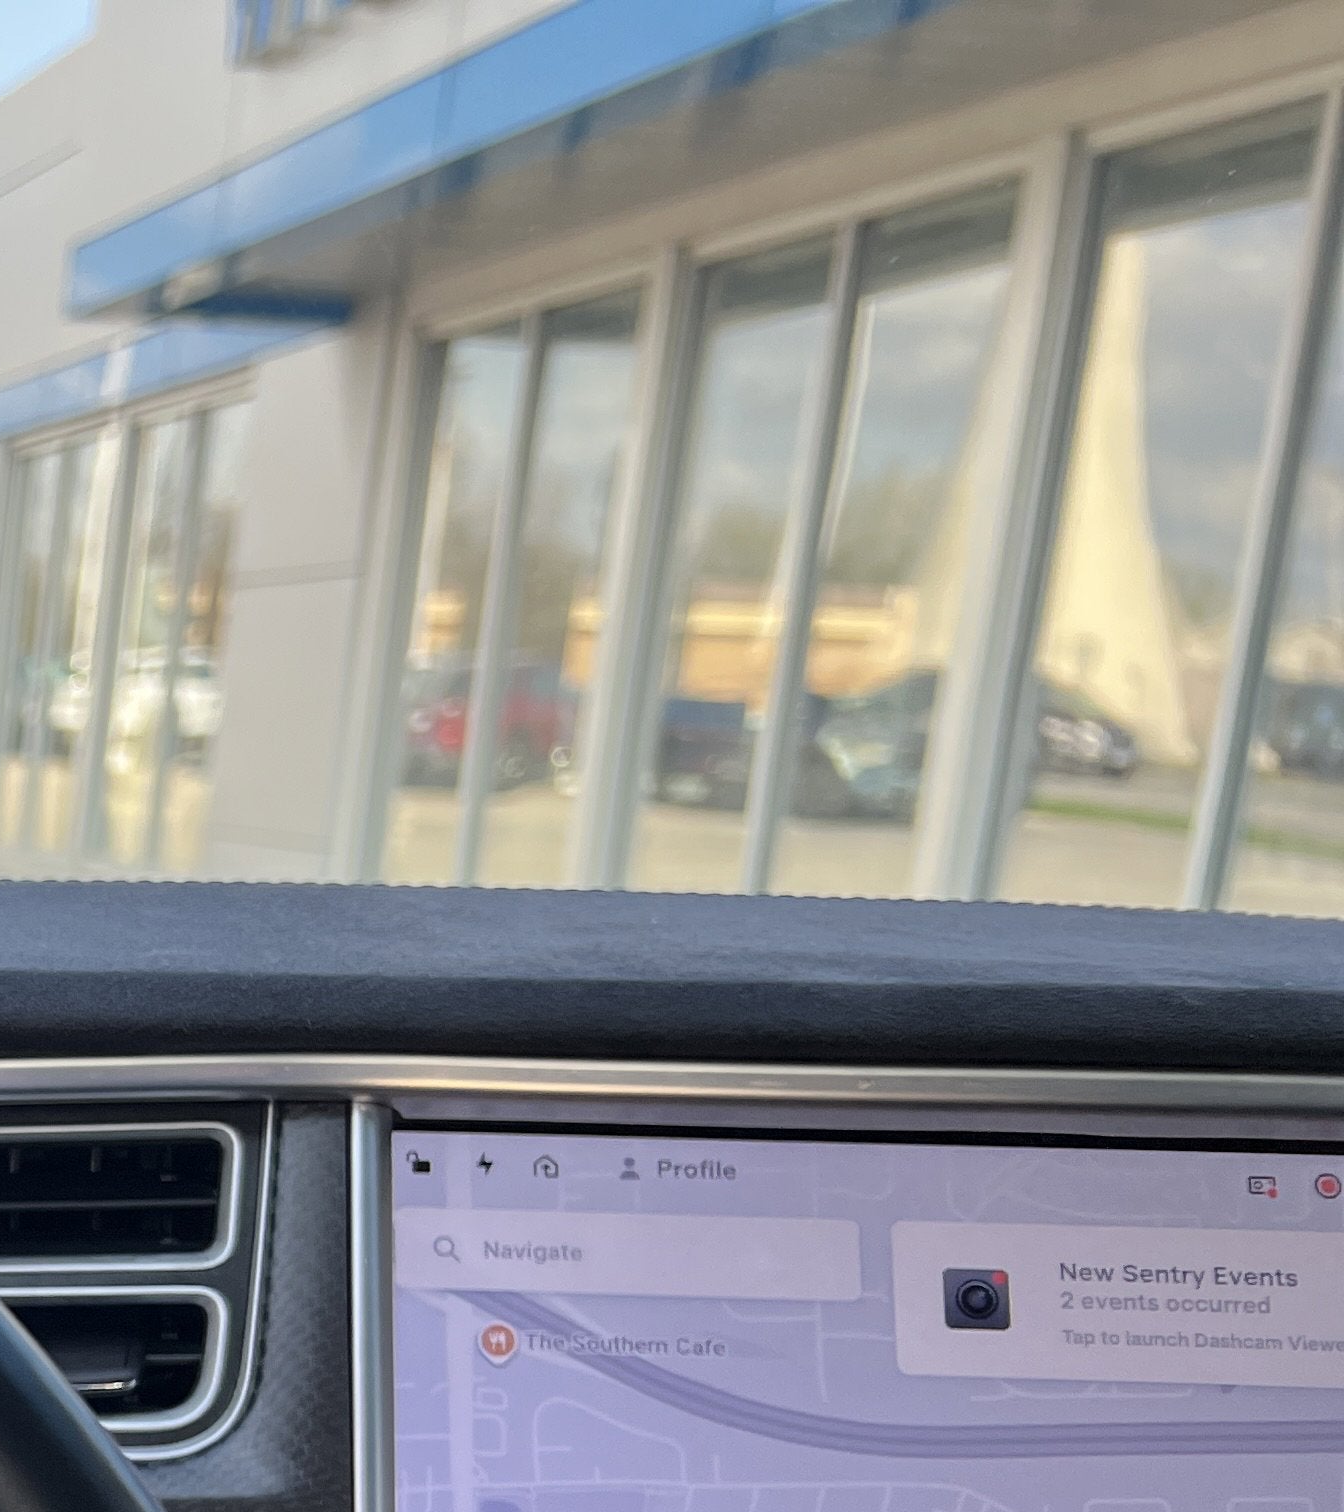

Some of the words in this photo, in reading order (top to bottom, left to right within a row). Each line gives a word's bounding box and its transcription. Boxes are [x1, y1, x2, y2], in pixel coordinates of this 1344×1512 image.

[657, 1158, 737, 1181] Profile
[483, 1240, 584, 1264] Navigate
[1059, 1262, 1114, 1282] New
[1122, 1264, 1206, 1290] Sentry
[1213, 1266, 1299, 1287] Events
[1060, 1290, 1075, 1310] 2
[1081, 1293, 1160, 1312] events
[1166, 1296, 1271, 1314] occurred
[527, 1333, 564, 1352] The
[573, 1334, 668, 1356] Southern
[676, 1337, 726, 1357] Cafe
[1062, 1329, 1096, 1348] Tap
[1101, 1331, 1120, 1346] to
[1126, 1331, 1189, 1348] launch
[1194, 1332, 1284, 1350] Dashcam
